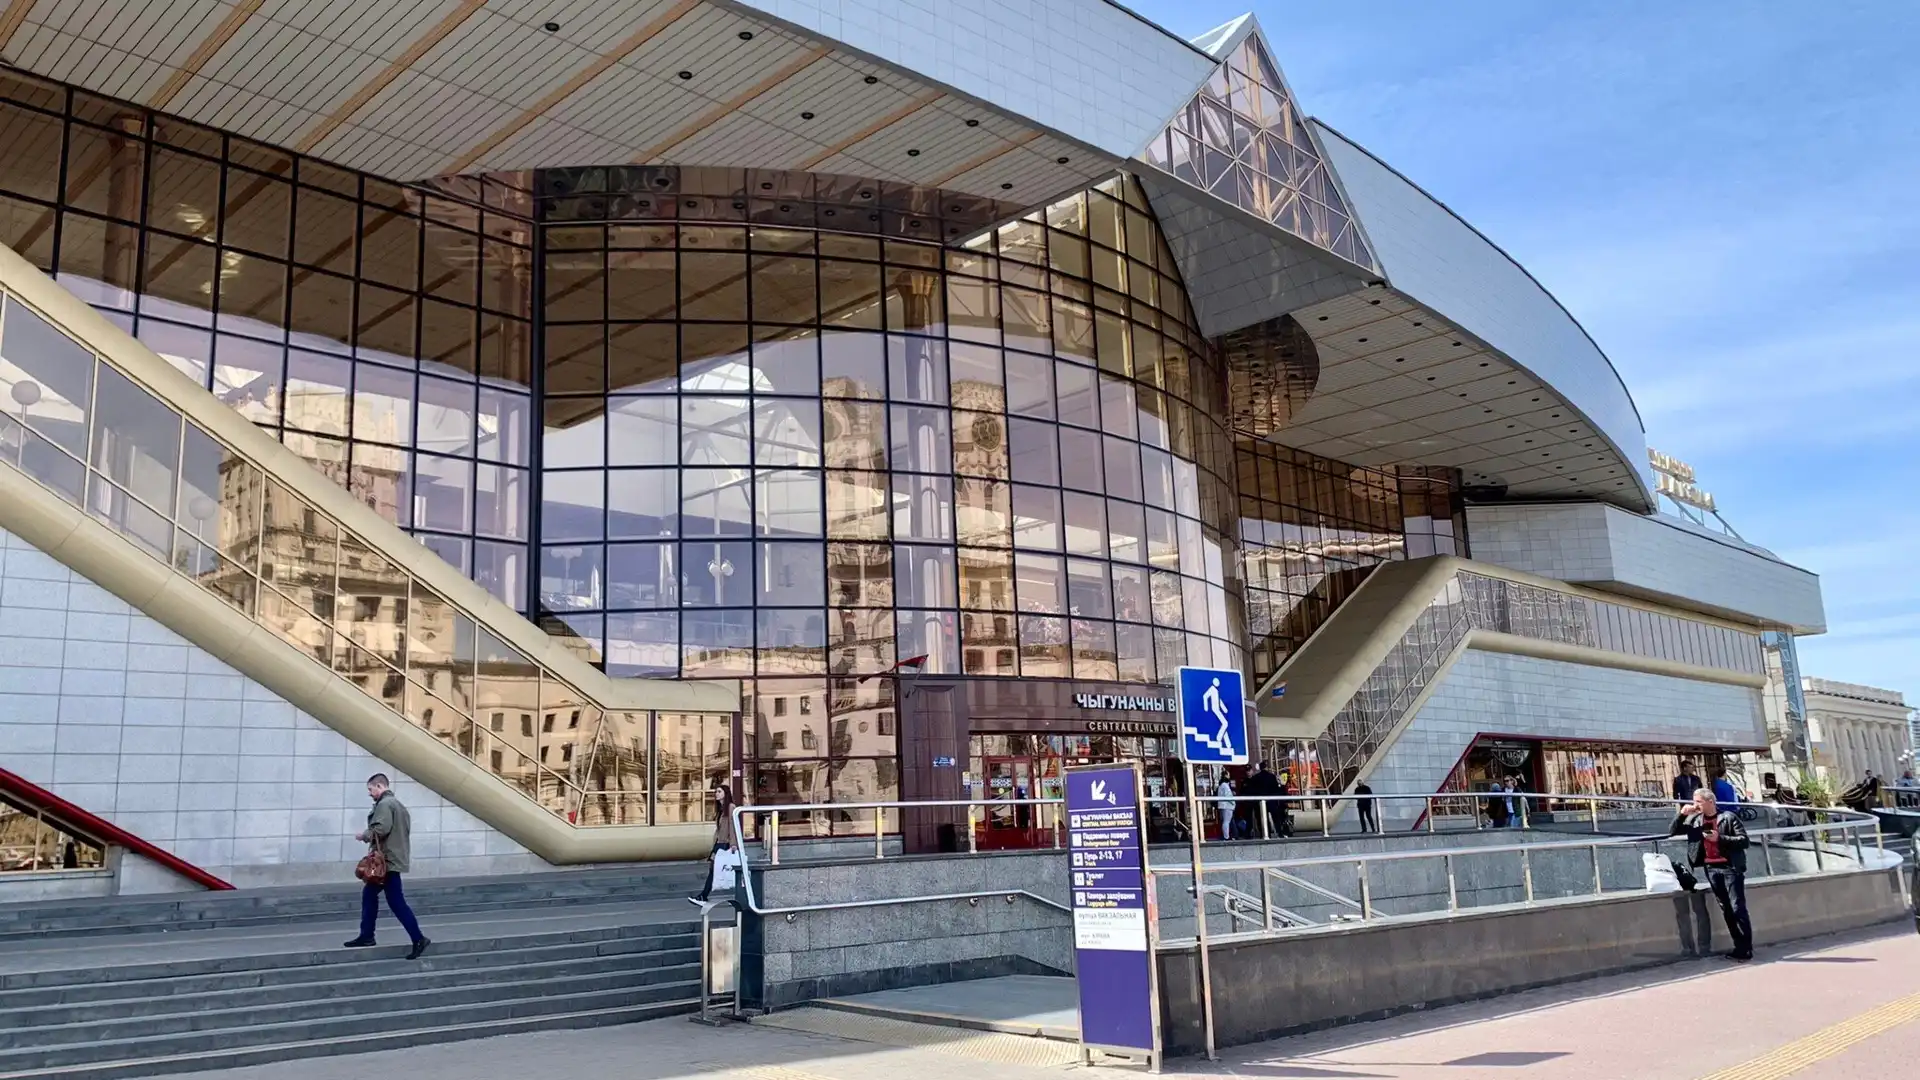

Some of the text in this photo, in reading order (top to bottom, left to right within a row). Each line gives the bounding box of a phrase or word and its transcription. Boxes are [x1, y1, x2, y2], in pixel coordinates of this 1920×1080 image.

[1076, 693, 1165, 712] ЧЫГУНАЧНЫ
[1088, 722, 1132, 732] CENTRAL
[1134, 723, 1169, 733] RAILWAY
[1115, 850, 1123, 859] 17
[1085, 872, 1104, 881] Туалет
